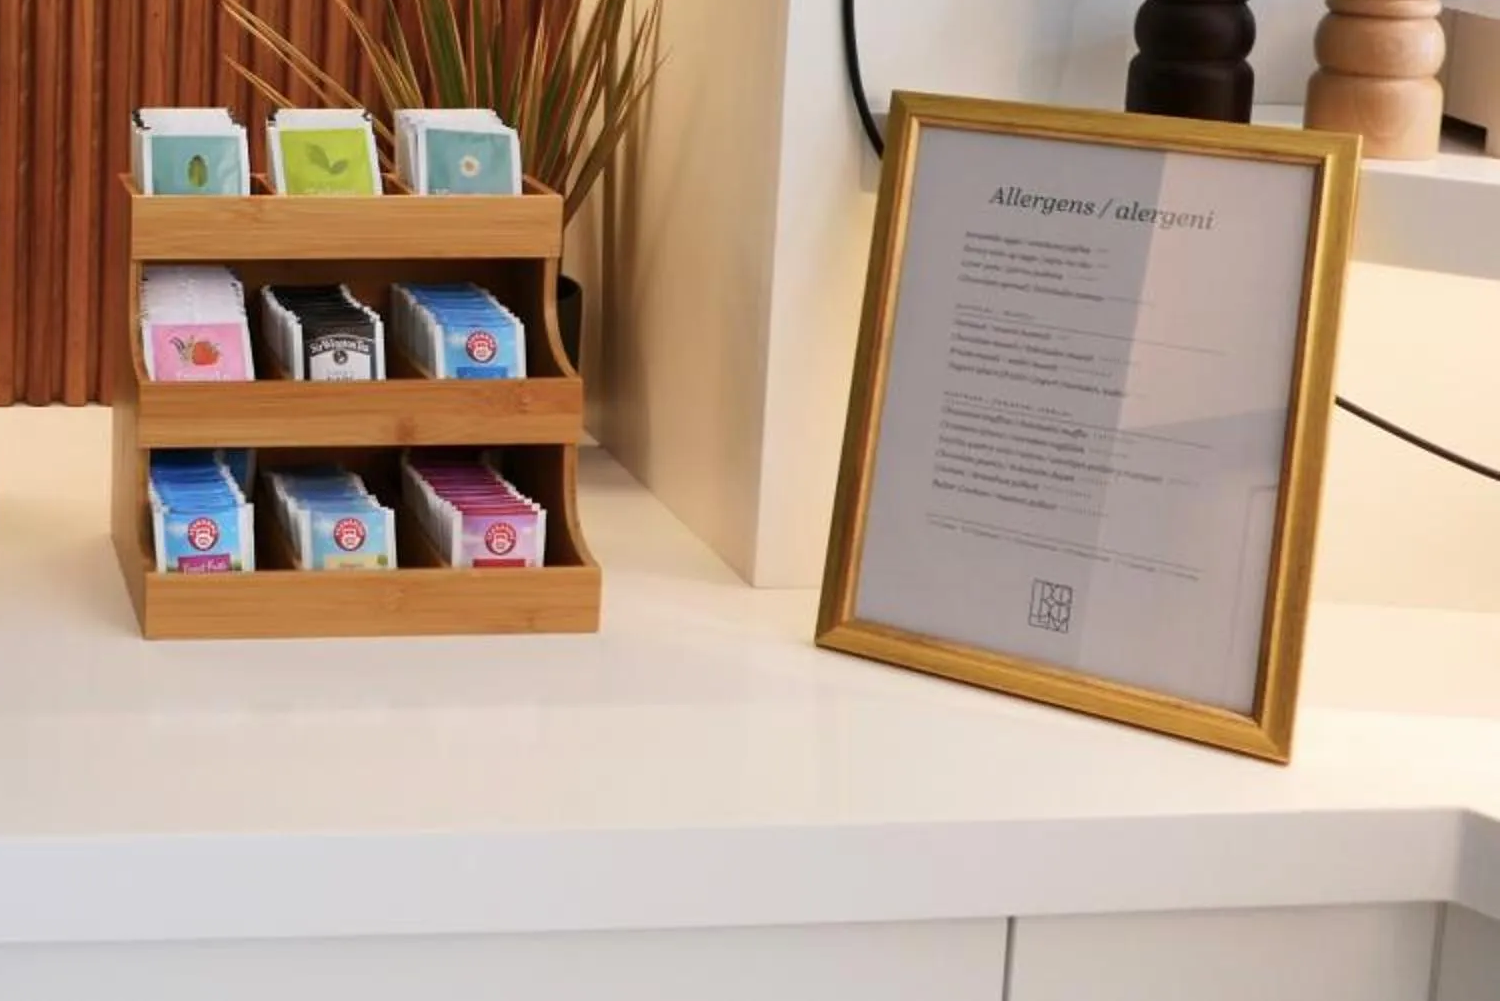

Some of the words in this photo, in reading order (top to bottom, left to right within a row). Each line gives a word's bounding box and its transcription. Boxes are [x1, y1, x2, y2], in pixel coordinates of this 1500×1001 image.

[989, 186, 1095, 216] Allergens
[1100, 198, 1114, 220] /
[1115, 201, 1215, 230] alergeni
